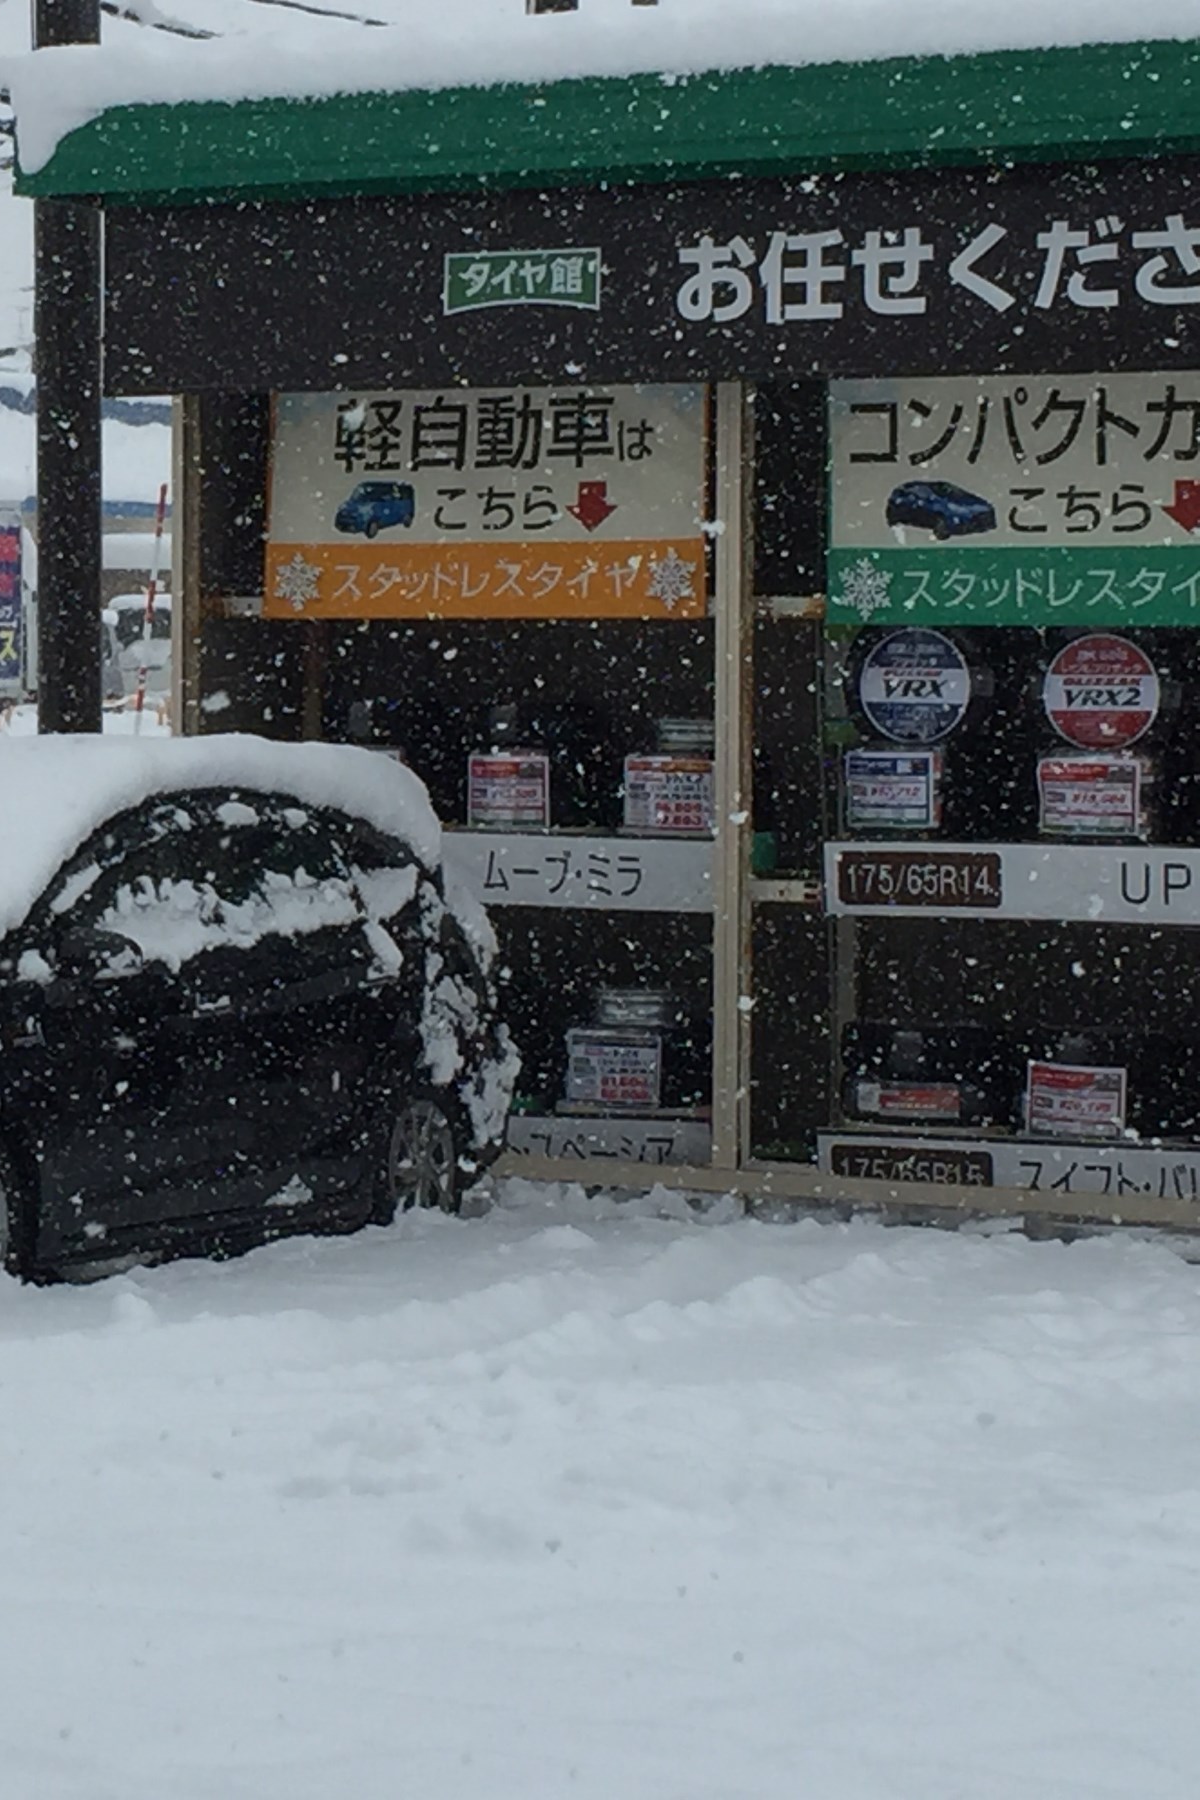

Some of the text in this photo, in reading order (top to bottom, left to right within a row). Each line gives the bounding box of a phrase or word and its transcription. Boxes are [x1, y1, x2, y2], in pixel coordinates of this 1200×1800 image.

[458, 257, 584, 297] タイヤ館
[676, 214, 1200, 324] お任せくださ
[334, 392, 654, 472] 軽自動車は
[849, 384, 1200, 466] コンパクトカ
[434, 485, 557, 531] こちら
[1007, 484, 1151, 534] こちら
[333, 560, 639, 599] スタッドレスタイヤ
[903, 567, 1200, 609] スタッドレスタイ
[883, 679, 948, 698] VRX
[1063, 687, 1141, 708] VRX2
[484, 850, 642, 895] ムーブ・ミラ
[846, 863, 992, 897] 175/65R14
[1121, 861, 1192, 905] UP
